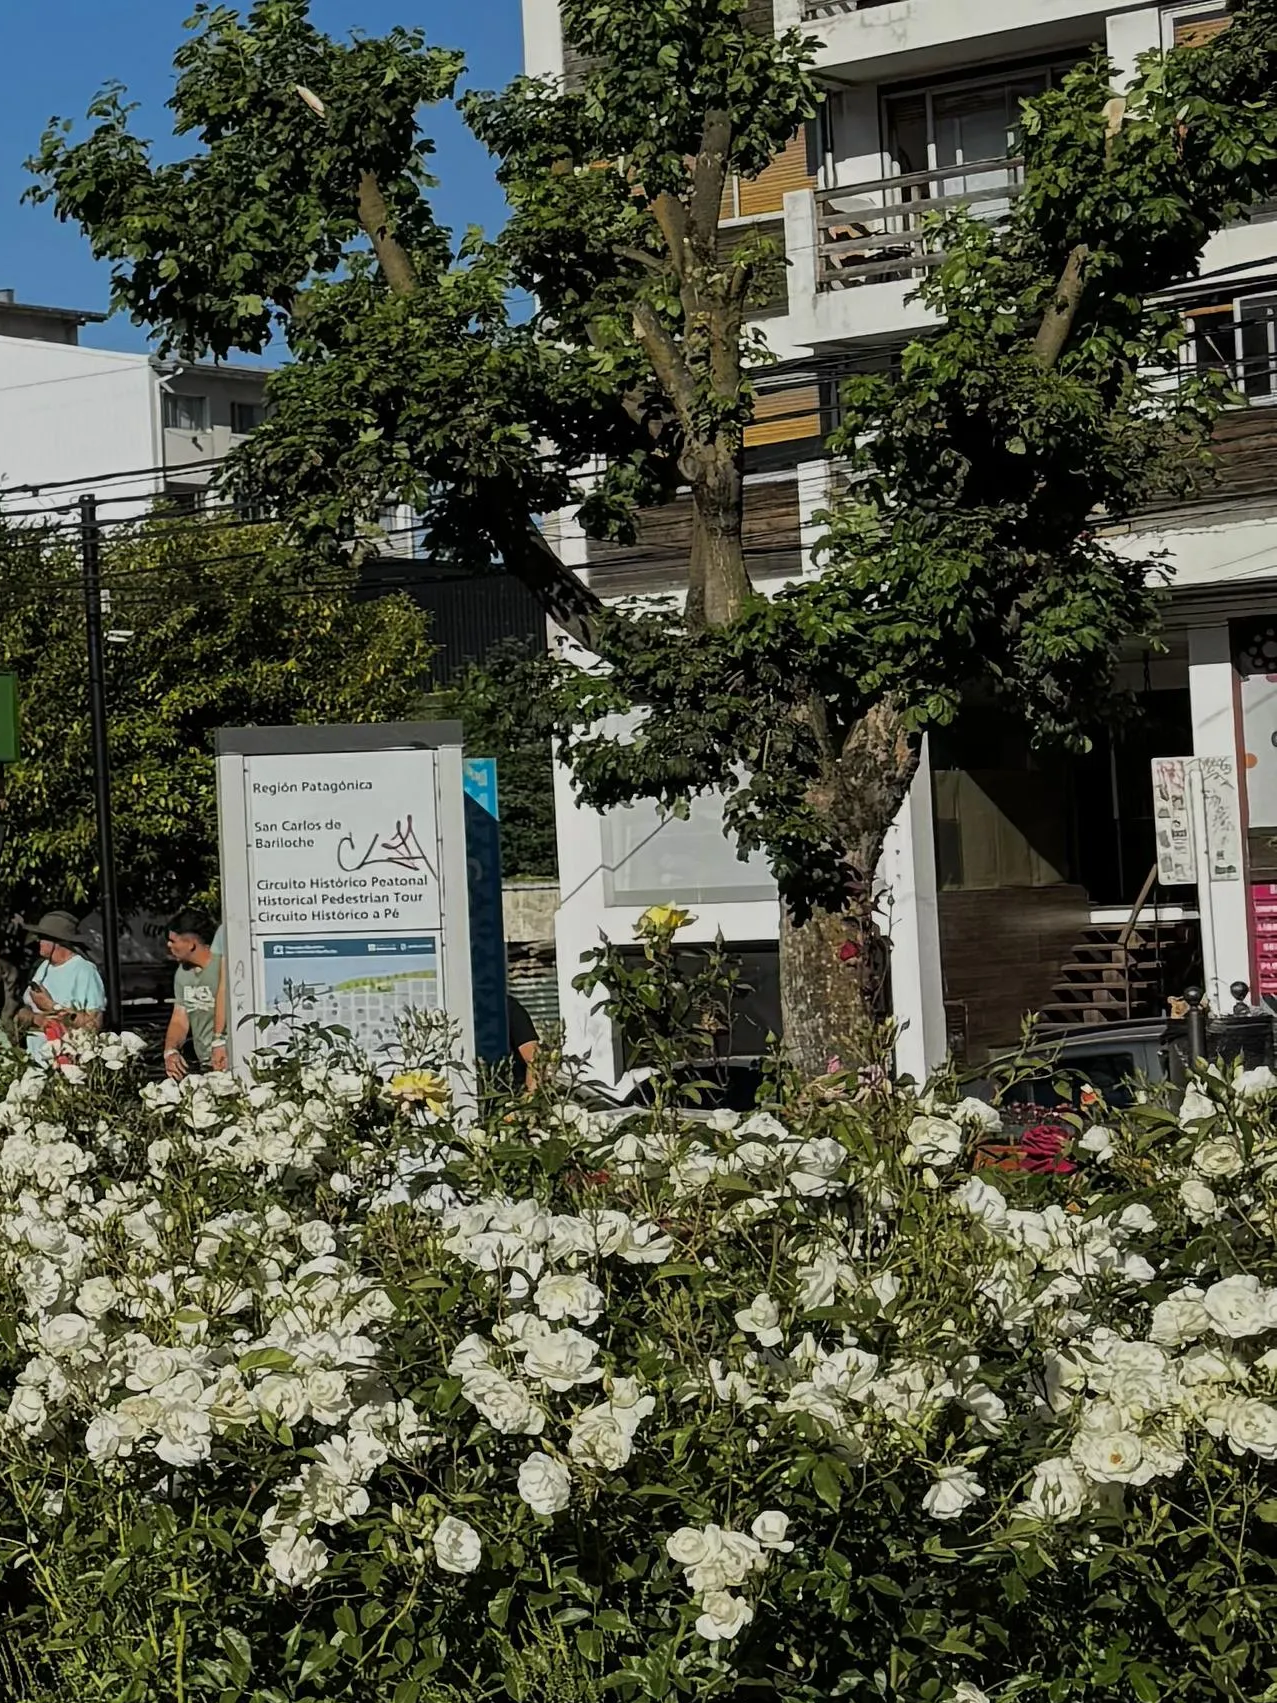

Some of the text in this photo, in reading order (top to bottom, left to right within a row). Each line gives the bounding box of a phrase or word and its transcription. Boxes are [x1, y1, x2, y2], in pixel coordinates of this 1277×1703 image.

[253, 779, 373, 797] Región Patagónica
[254, 818, 342, 833] San Carlos de
[255, 838, 315, 849] Bariloche
[256, 874, 428, 891] Circuito Histórico Peatonal
[257, 891, 423, 907] Historical Pedestrian Tour
[257, 908, 400, 923] Circuito Histórico a Pé
